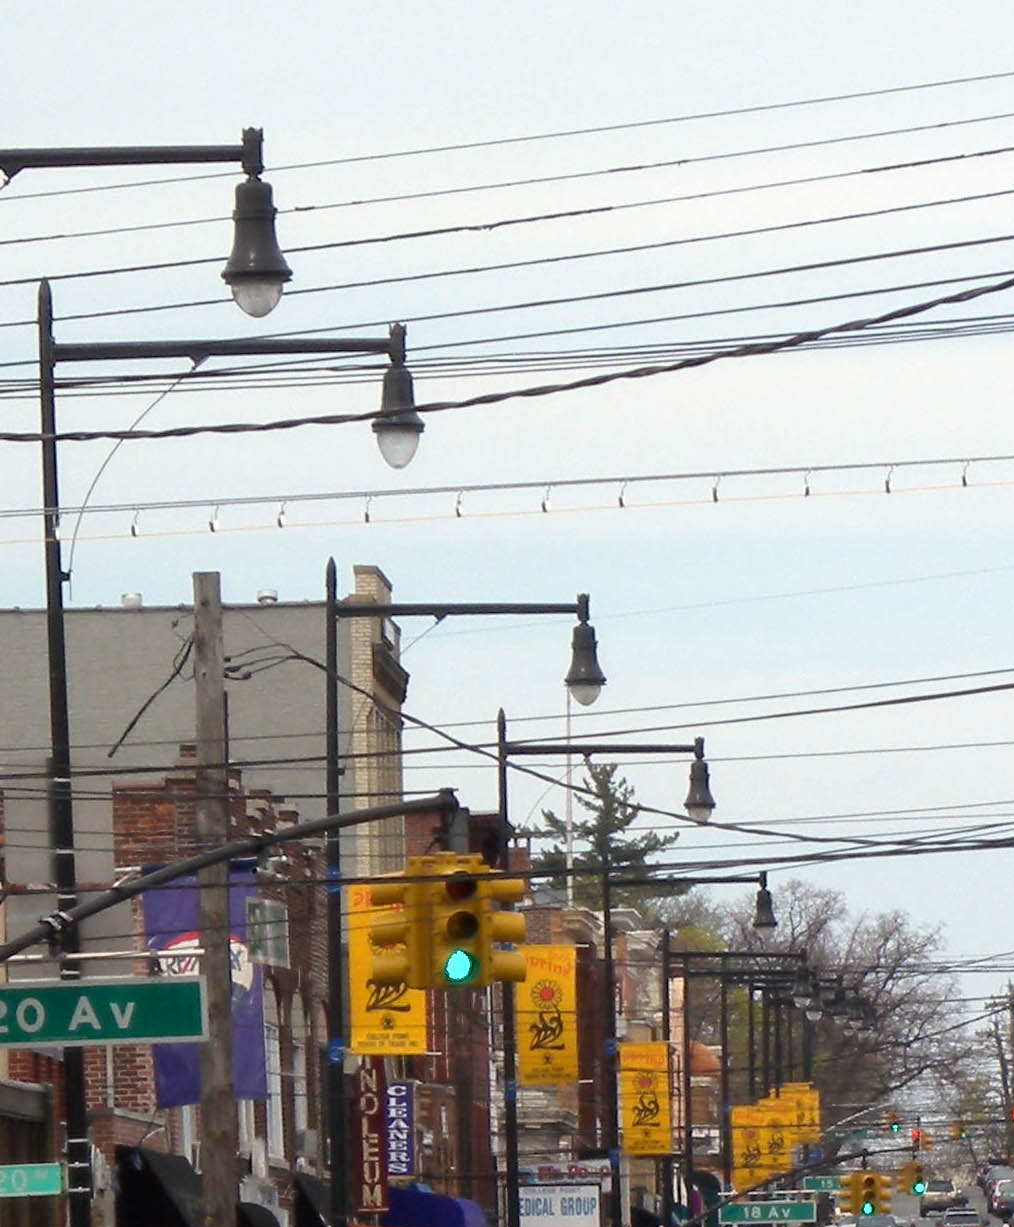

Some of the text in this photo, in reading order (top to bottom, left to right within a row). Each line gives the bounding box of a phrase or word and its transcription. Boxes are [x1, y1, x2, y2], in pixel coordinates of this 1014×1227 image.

[68, 996, 136, 1031] Av
[360, 1056, 382, 1207] INOLEUM
[387, 1085, 410, 1174] CLEANERS
[519, 1197, 597, 1216] EDICAL GROUP
[744, 1207, 791, 1219] 18 Av
